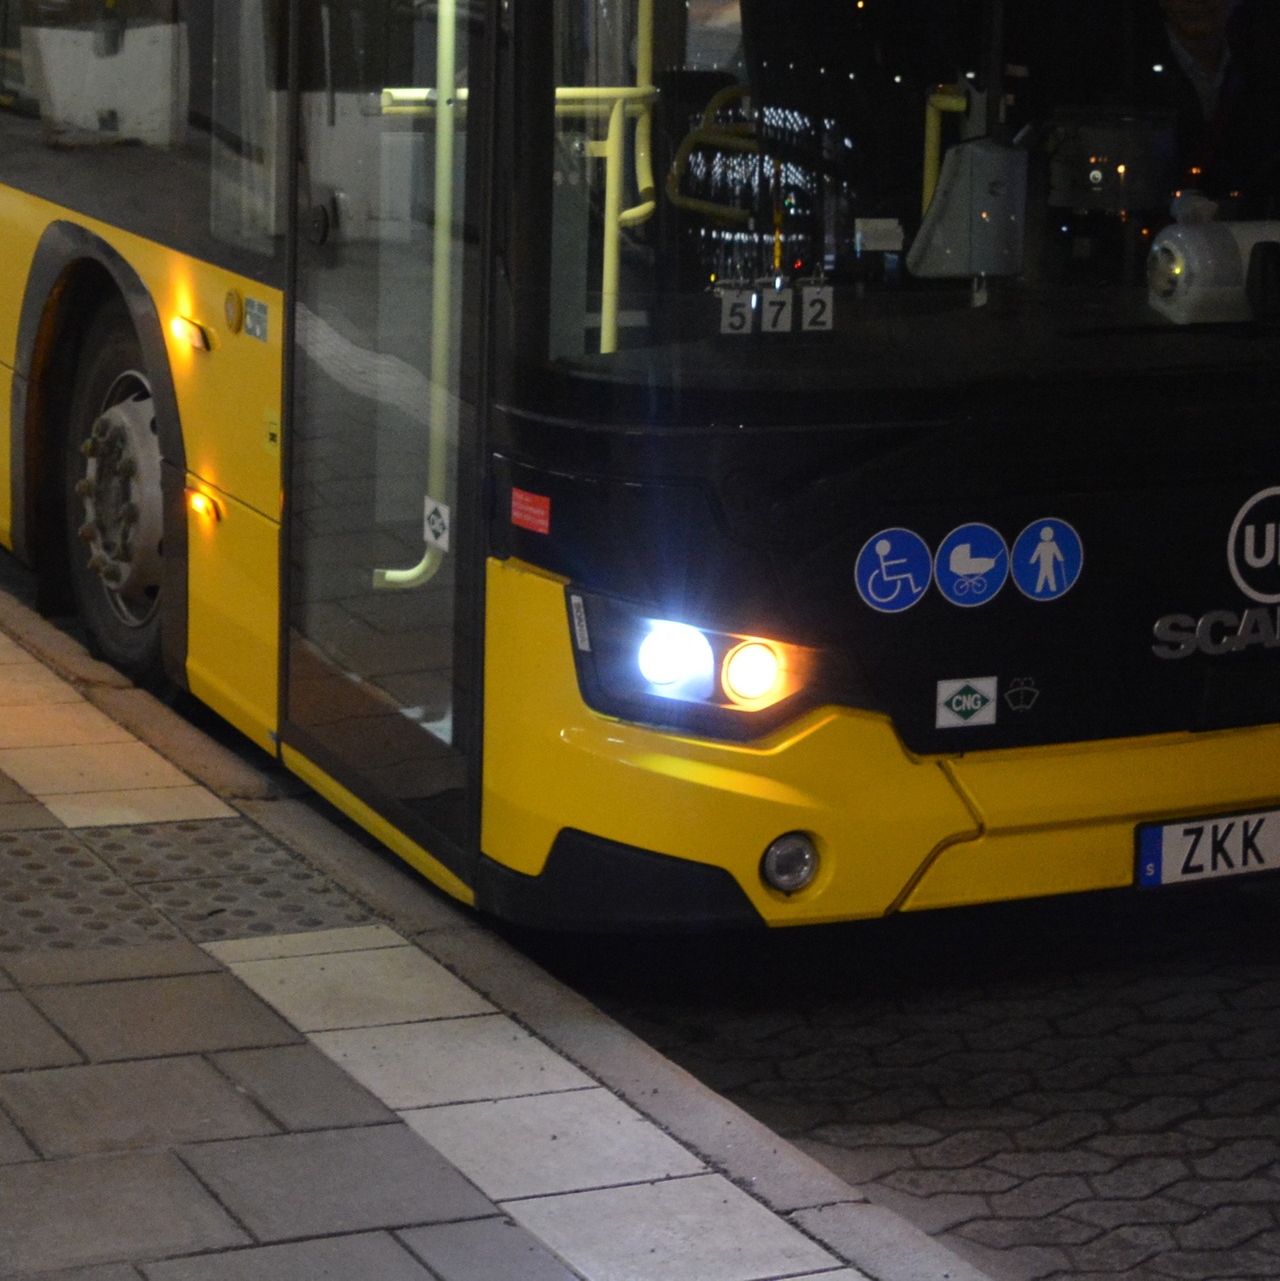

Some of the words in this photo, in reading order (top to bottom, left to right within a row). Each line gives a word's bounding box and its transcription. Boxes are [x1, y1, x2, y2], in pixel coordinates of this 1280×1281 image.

[951, 693, 983, 712] CNG
[1145, 862, 1155, 876] S
[1181, 819, 1265, 875] ZKK
